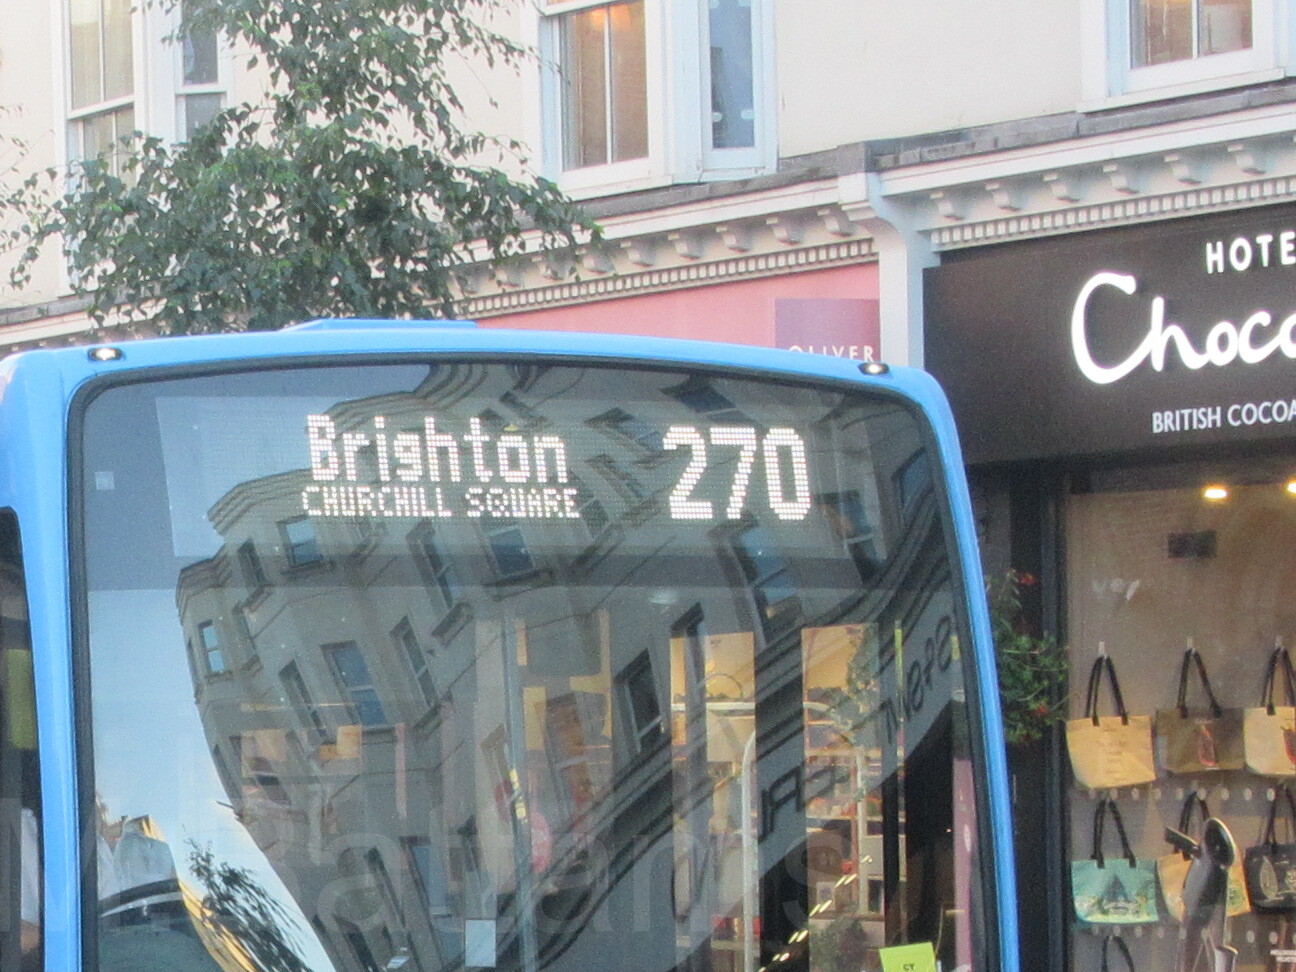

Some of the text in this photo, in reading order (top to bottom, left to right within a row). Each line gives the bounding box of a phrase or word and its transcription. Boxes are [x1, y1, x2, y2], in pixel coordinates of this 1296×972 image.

[1152, 405, 1222, 434] BRITISH
[307, 413, 811, 521] Brighton 270
[302, 485, 581, 519] CHURCHILL SQUARE
